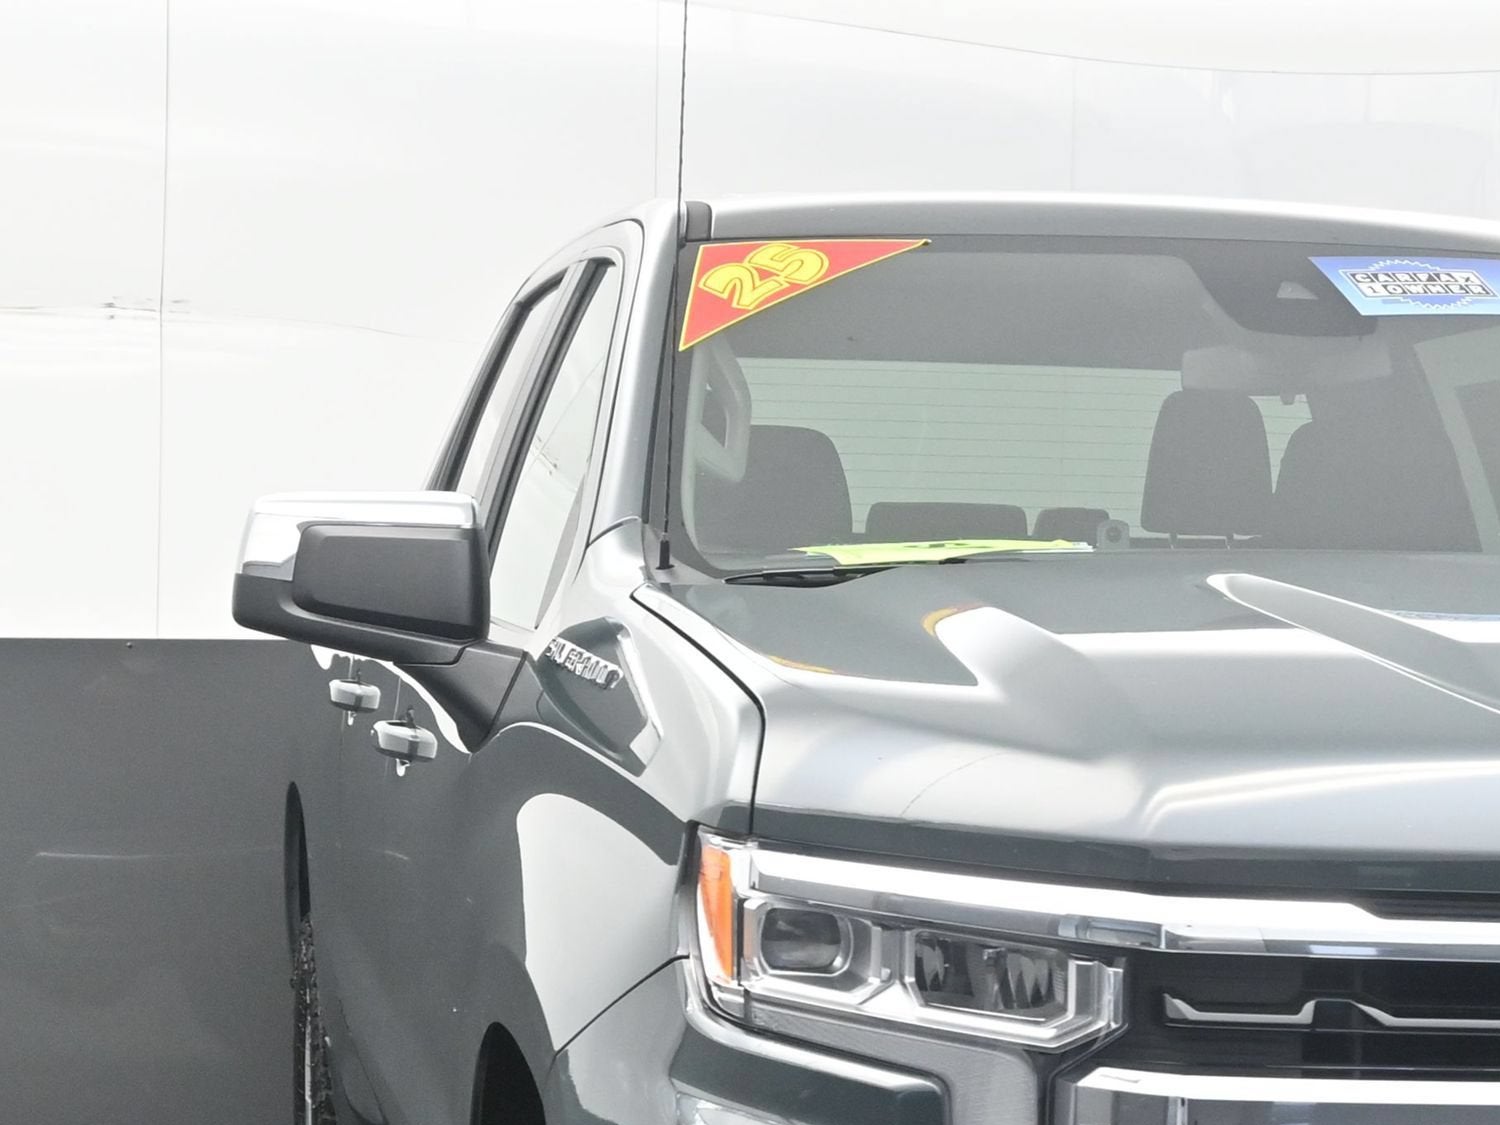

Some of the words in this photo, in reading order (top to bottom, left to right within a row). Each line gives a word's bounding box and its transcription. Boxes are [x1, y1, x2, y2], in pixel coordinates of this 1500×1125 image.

[699, 243, 829, 310] 25
[1352, 272, 1479, 284] CARFAX
[1385, 283, 1489, 295] OWNER
[545, 637, 624, 690] SILERADO
